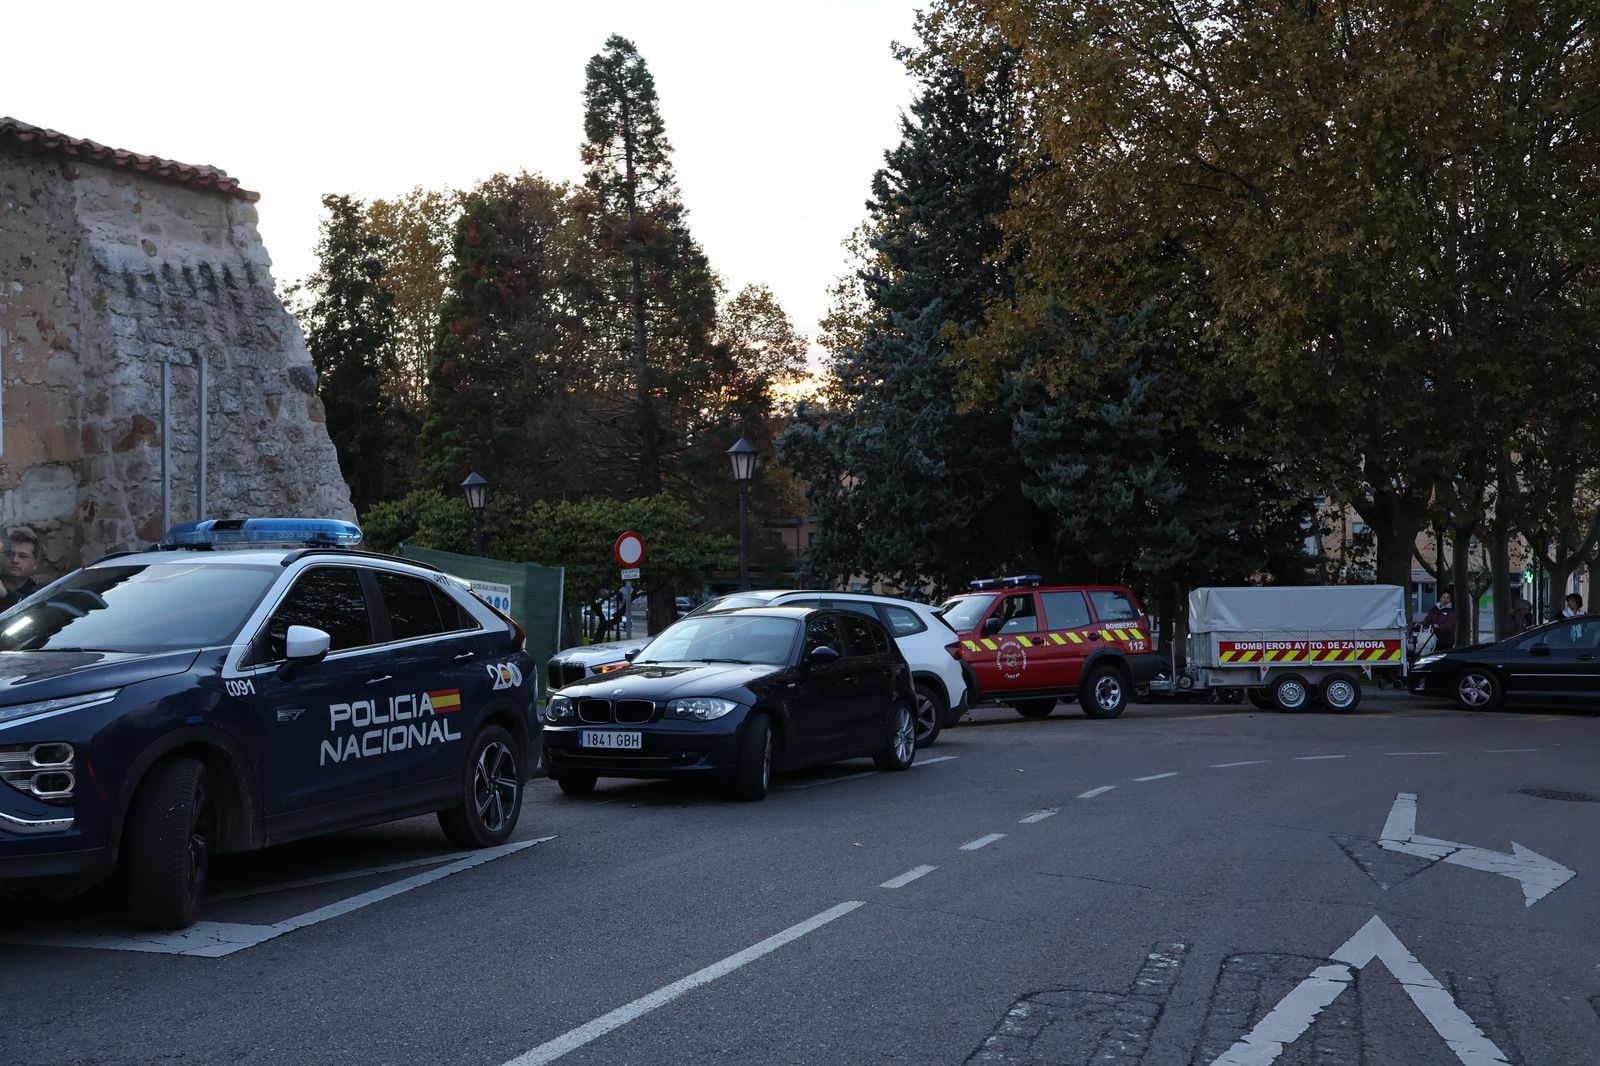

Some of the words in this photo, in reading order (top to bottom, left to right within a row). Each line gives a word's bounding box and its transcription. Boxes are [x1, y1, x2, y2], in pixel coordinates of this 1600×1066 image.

[1105, 622, 1138, 630] BOMBEROS
[1128, 641, 1145, 651] 112
[1234, 641, 1292, 651] BOMBEROS
[1327, 641, 1340, 650] DE
[1341, 640, 1386, 650] ZAMORA
[329, 692, 435, 731] POLICÍA
[319, 717, 462, 767] NACIONAL
[586, 732, 612, 747] 1841
[616, 732, 639, 747] GBH
